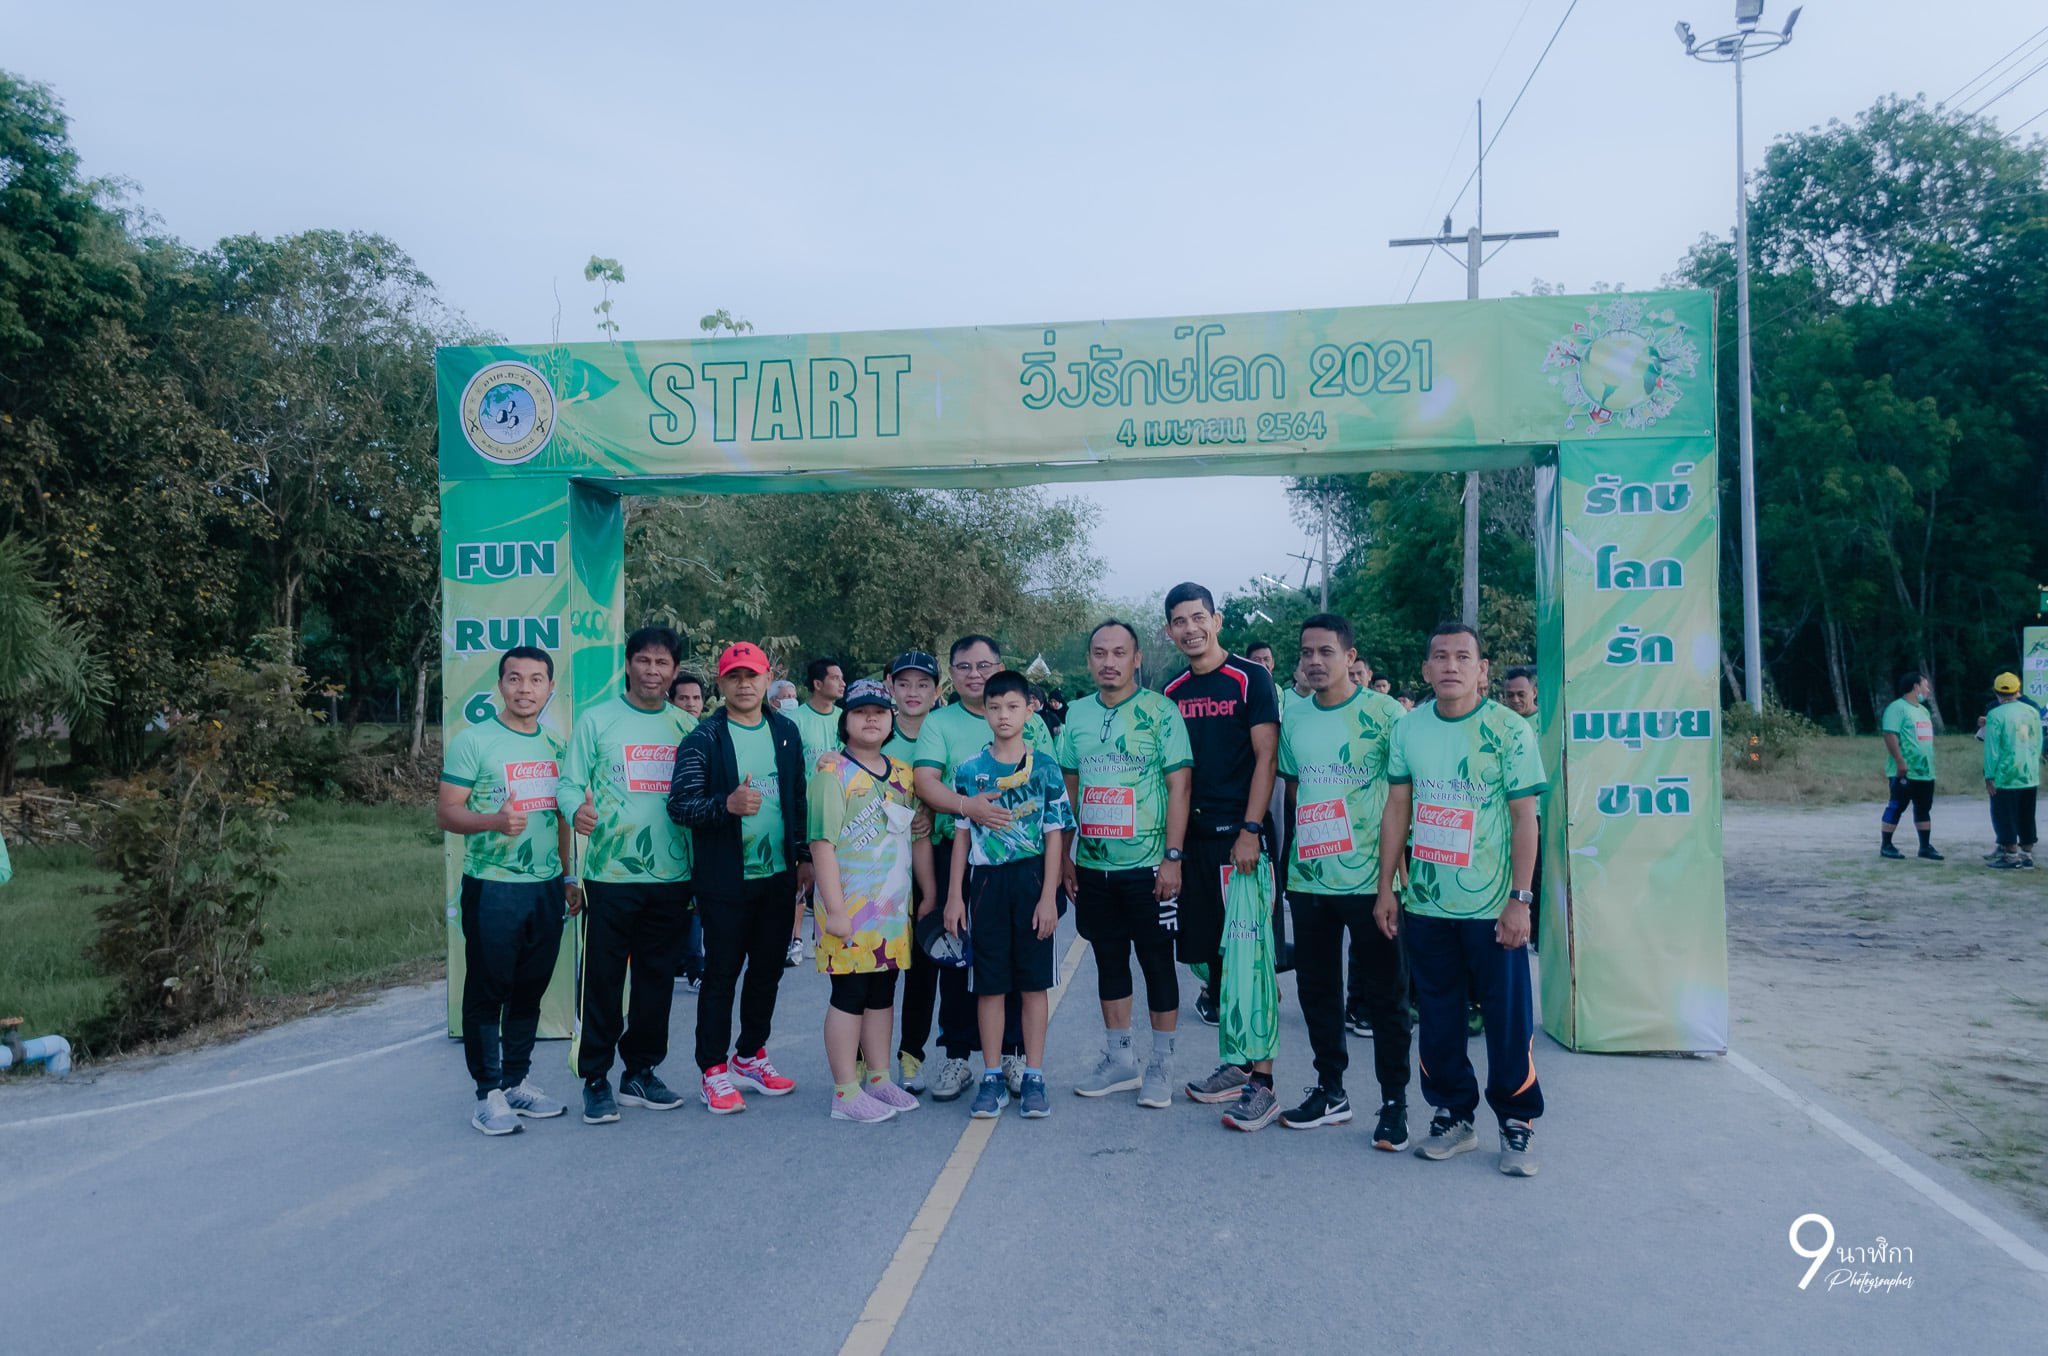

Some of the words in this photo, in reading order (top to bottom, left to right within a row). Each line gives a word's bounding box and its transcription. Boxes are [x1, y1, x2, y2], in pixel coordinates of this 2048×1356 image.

[1021, 324, 1286, 410] วิ่งรักษ์โลก
[1309, 339, 1434, 398] 2021
[649, 354, 912, 446] START
[1117, 418, 1137, 447] 4
[1144, 417, 1247, 446] เมษายน
[1257, 410, 1327, 442] 2564
[1583, 462, 1695, 516] รักษ์
[456, 541, 557, 579] FUN
[1594, 543, 1685, 591] โลก
[455, 616, 561, 652] RUN
[1604, 623, 1675, 667] รัก
[1570, 708, 1713, 751] มนุษย
[1414, 778, 1445, 790] RANG
[1596, 776, 1692, 817] ชาติ
